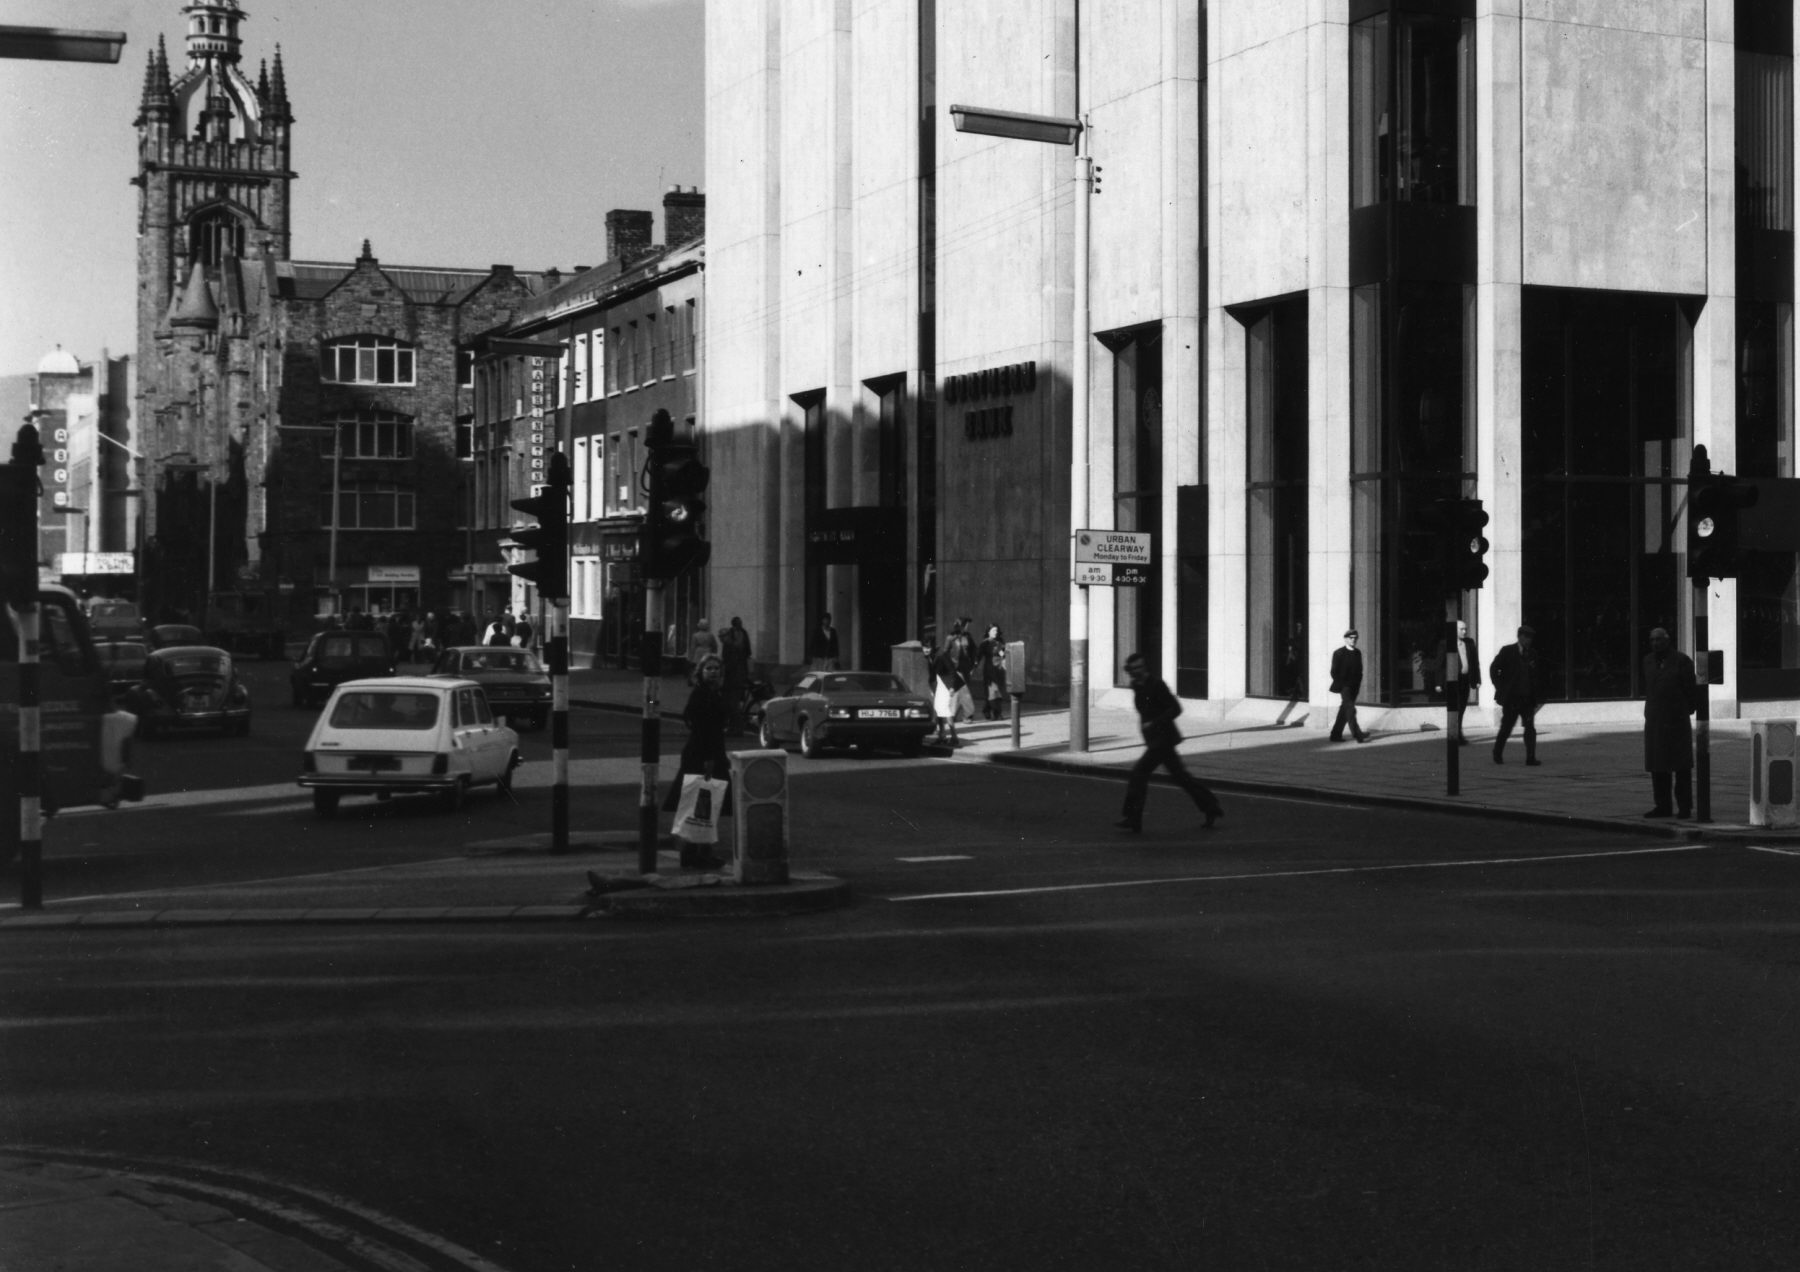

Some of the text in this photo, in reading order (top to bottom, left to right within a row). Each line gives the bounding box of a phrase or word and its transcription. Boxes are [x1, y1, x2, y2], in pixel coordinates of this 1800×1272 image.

[1106, 535, 1136, 544] URBAN
[1097, 544, 1144, 553] CLEARWAY
[1094, 553, 1119, 561] Monday
[1128, 554, 1147, 562] Friday
